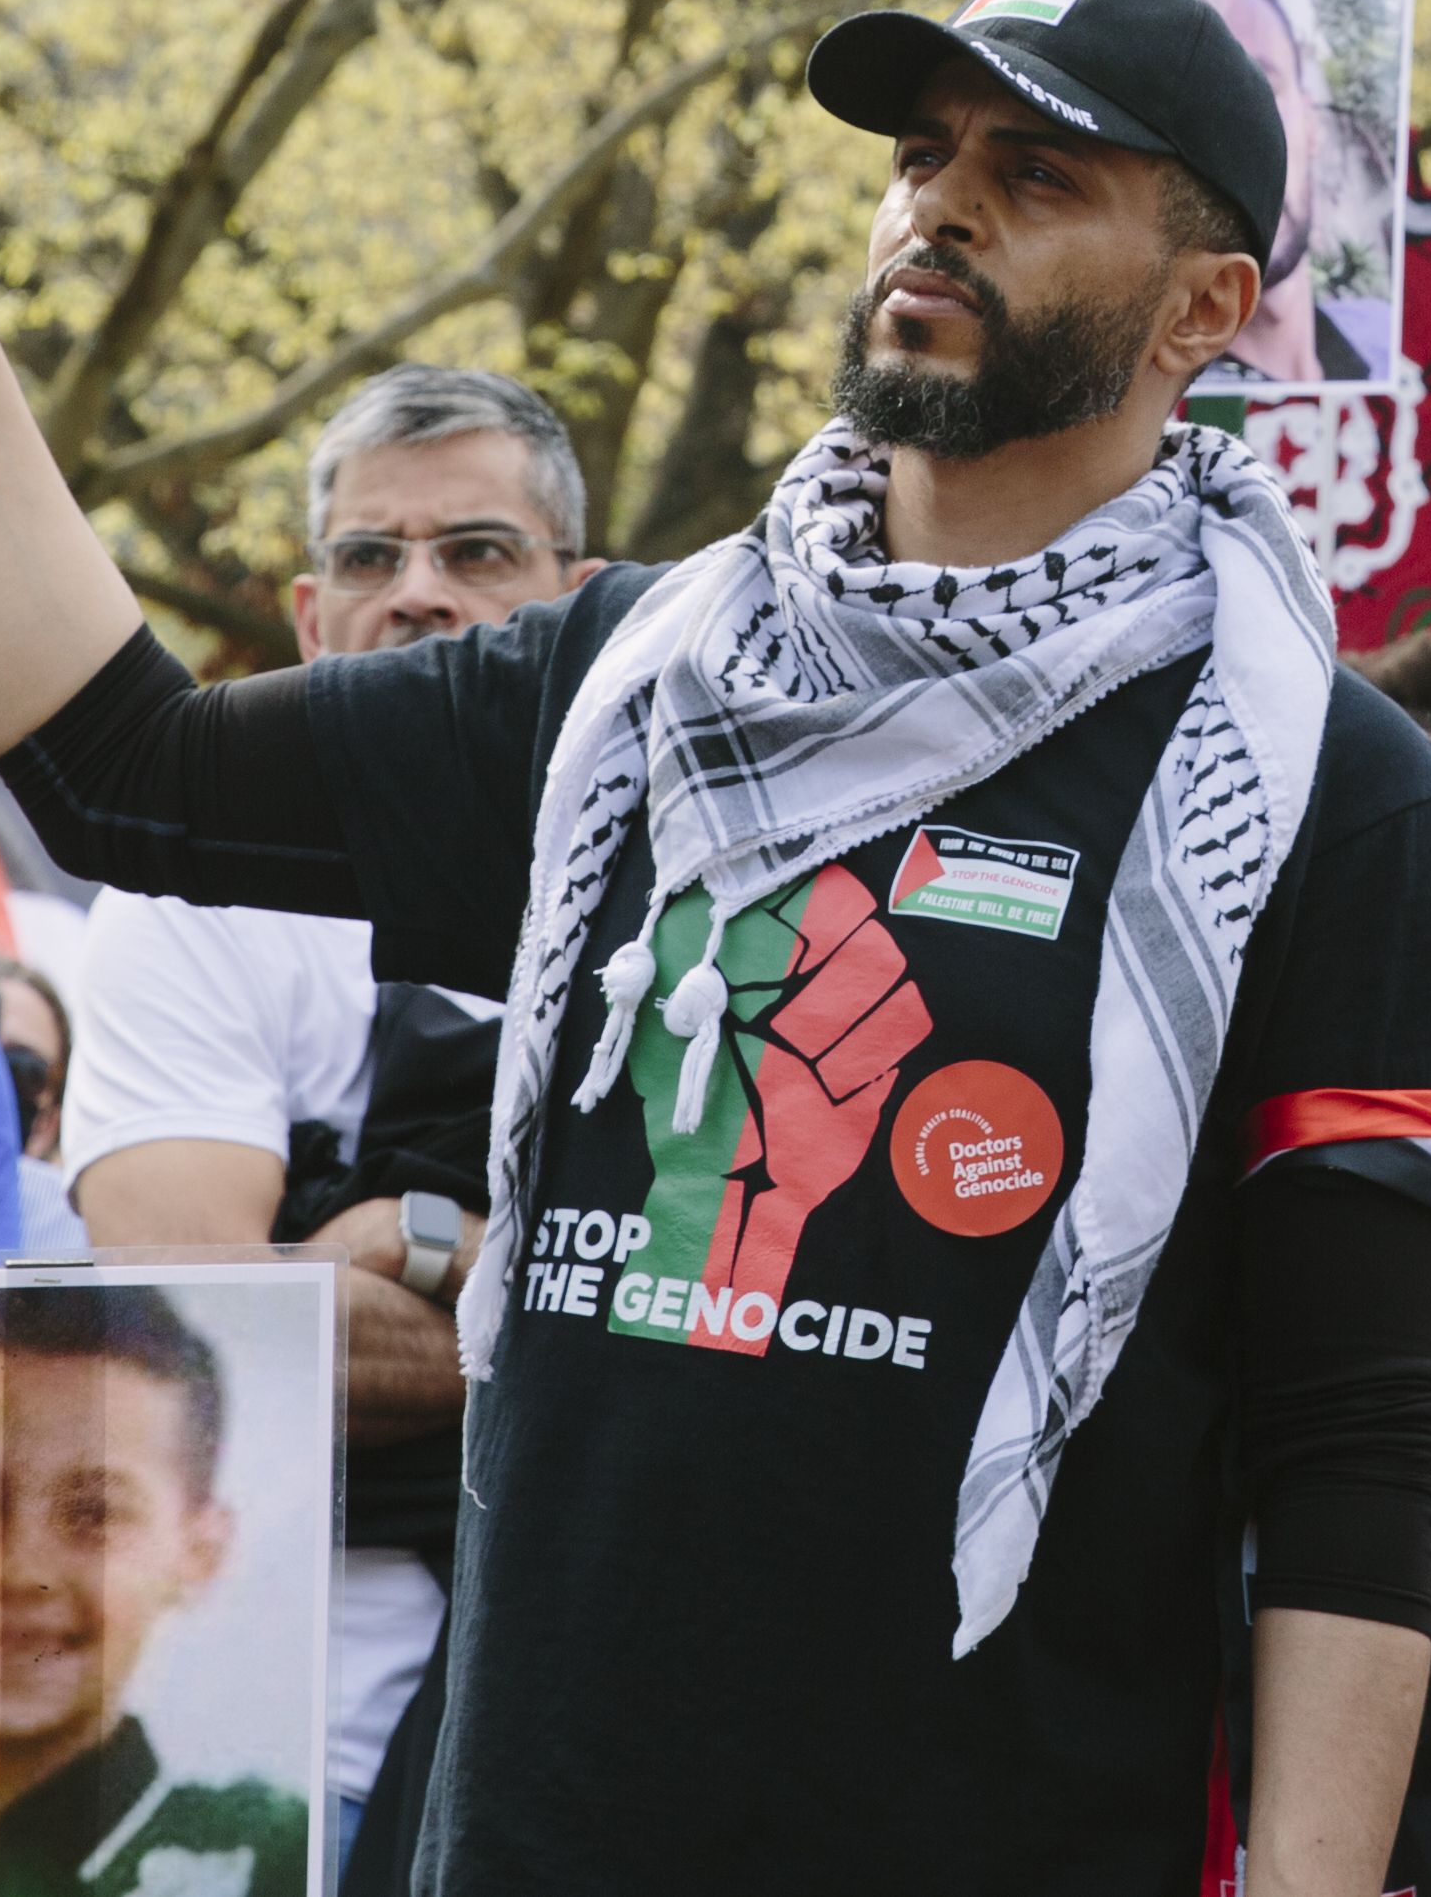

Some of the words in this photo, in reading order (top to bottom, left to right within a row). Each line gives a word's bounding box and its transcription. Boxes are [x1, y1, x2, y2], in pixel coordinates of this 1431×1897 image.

[970, 41, 1099, 132] PALESTINE
[1016, 853, 1029, 866] TO
[1032, 855, 1048, 869] THE
[1051, 856, 1069, 871] SEA
[952, 870, 977, 881] STOP
[979, 871, 1000, 883] THE
[1002, 874, 1060, 897] GENOCIDE
[918, 890, 976, 914] PALESTINE
[977, 900, 1004, 918] WILL
[1007, 907, 1023, 921] BE
[1026, 909, 1055, 926] FREE
[919, 1111, 948, 1139] HEALTH
[949, 1108, 994, 1135] COALITION
[914, 1141, 931, 1176] GLOBAL
[948, 1135, 1023, 1161] Doctors
[952, 1153, 1023, 1183] Against
[954, 1169, 1044, 1199] Genocide
[532, 1207, 652, 1263] STOP
[523, 1262, 605, 1317] THE
[612, 1272, 933, 1370] GENOCIDE
